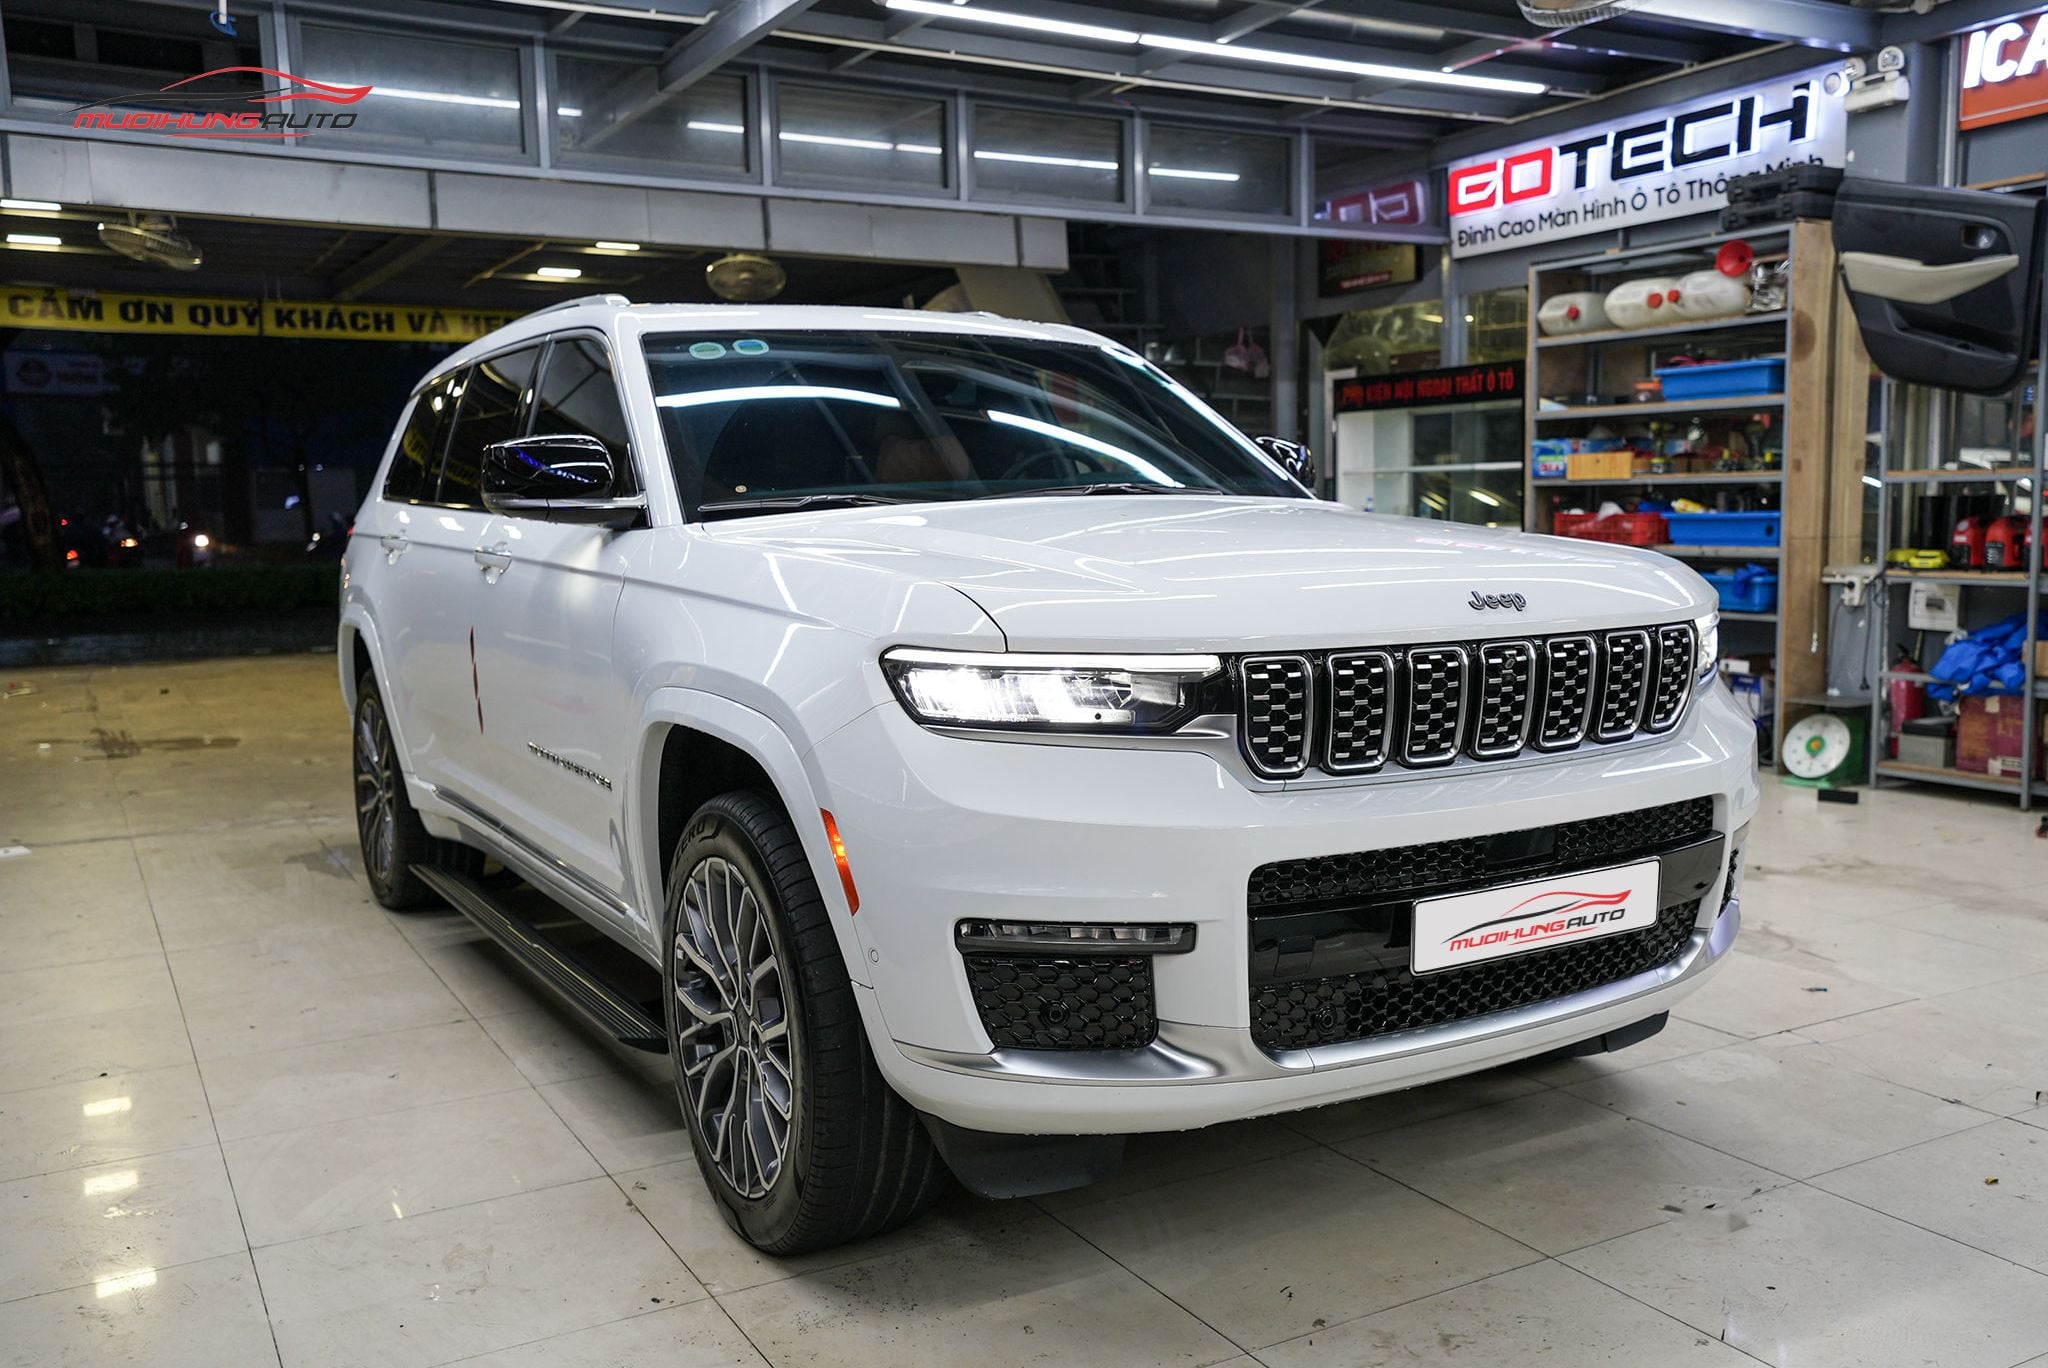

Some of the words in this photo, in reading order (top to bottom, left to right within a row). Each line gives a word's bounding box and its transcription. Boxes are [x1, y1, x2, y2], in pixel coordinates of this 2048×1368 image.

[1448, 79, 1818, 217] GOTECH
[1499, 219, 1536, 240] Cao
[1539, 207, 1579, 231] Màn
[1631, 186, 1648, 211] Ô
[1654, 182, 1681, 207] Tô
[1686, 170, 1761, 200] Thô
[8, 287, 104, 321] CẢM
[119, 299, 175, 324] ƠN
[275, 305, 395, 333] KHÁCH
[1468, 591, 1527, 612] Jeep
